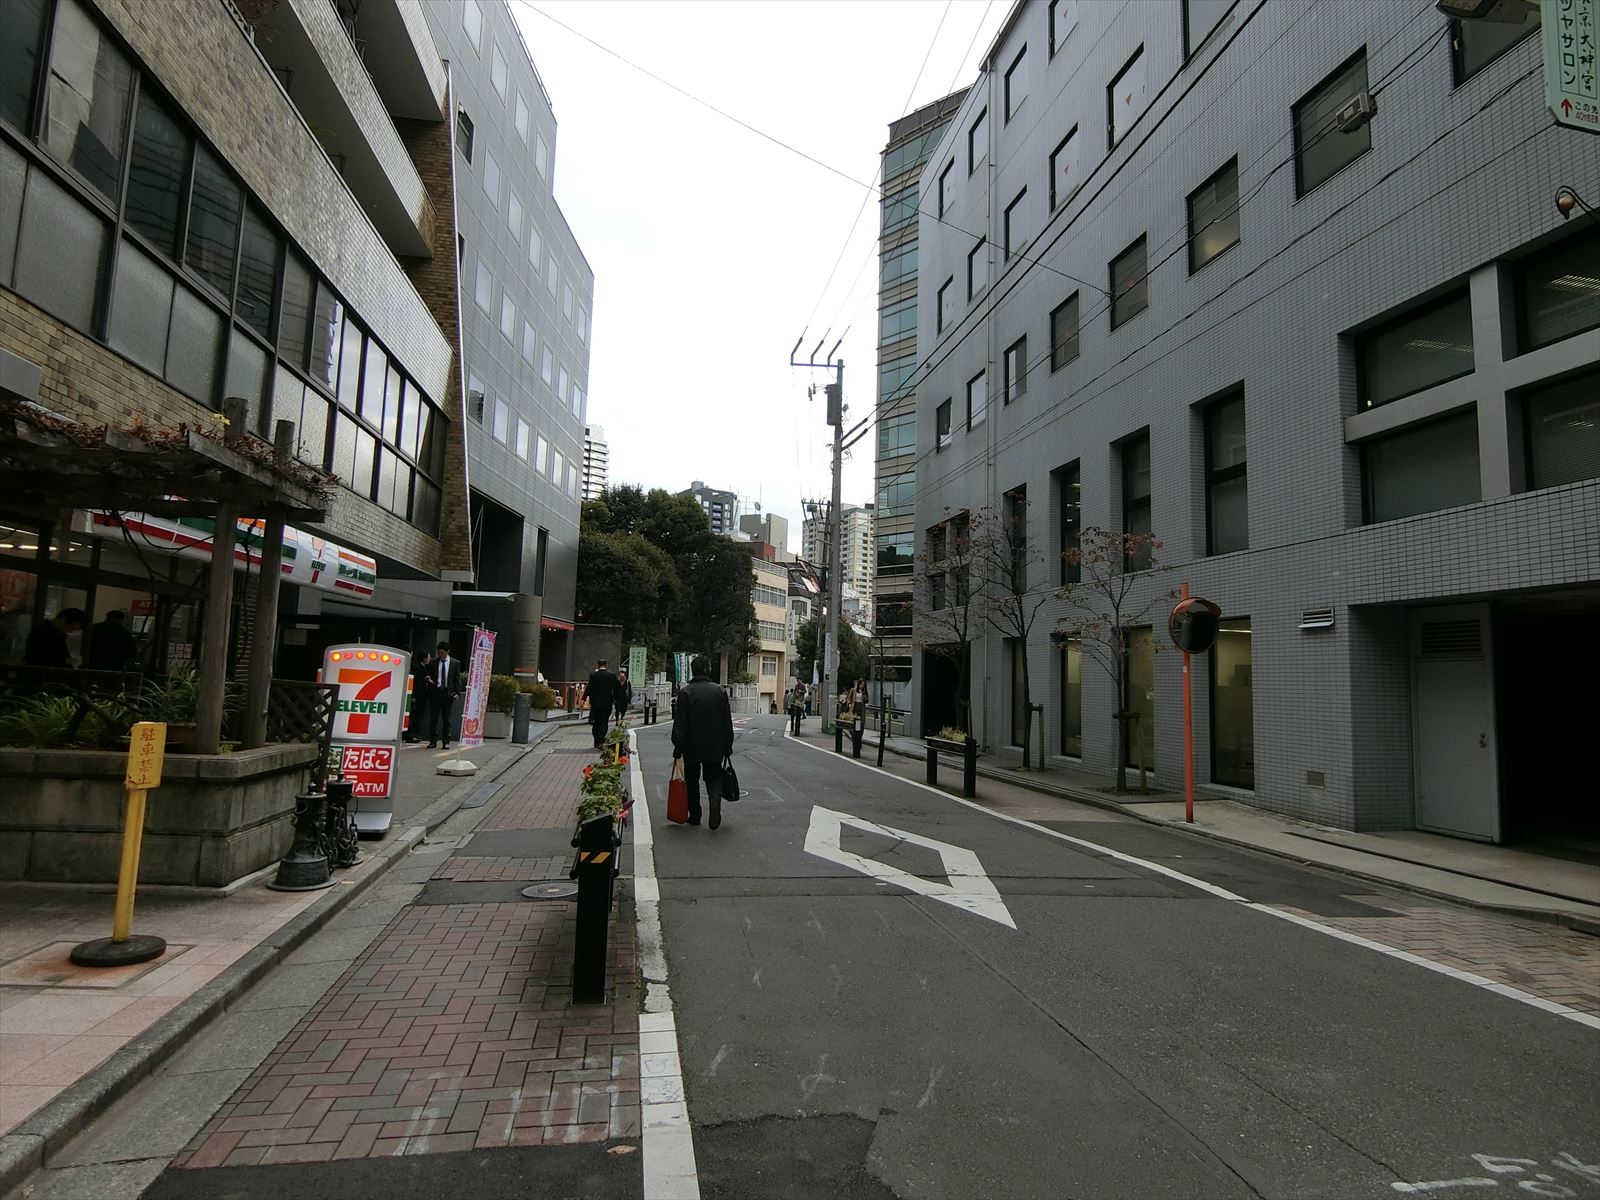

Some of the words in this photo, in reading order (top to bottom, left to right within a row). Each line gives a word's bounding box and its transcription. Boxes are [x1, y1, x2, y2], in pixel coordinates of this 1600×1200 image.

[1578, 0, 1594, 92] 京大神宮
[138, 728, 156, 785] 駐車禁止
[344, 748, 390, 769] たばこ
[355, 782, 385, 793] ATM
